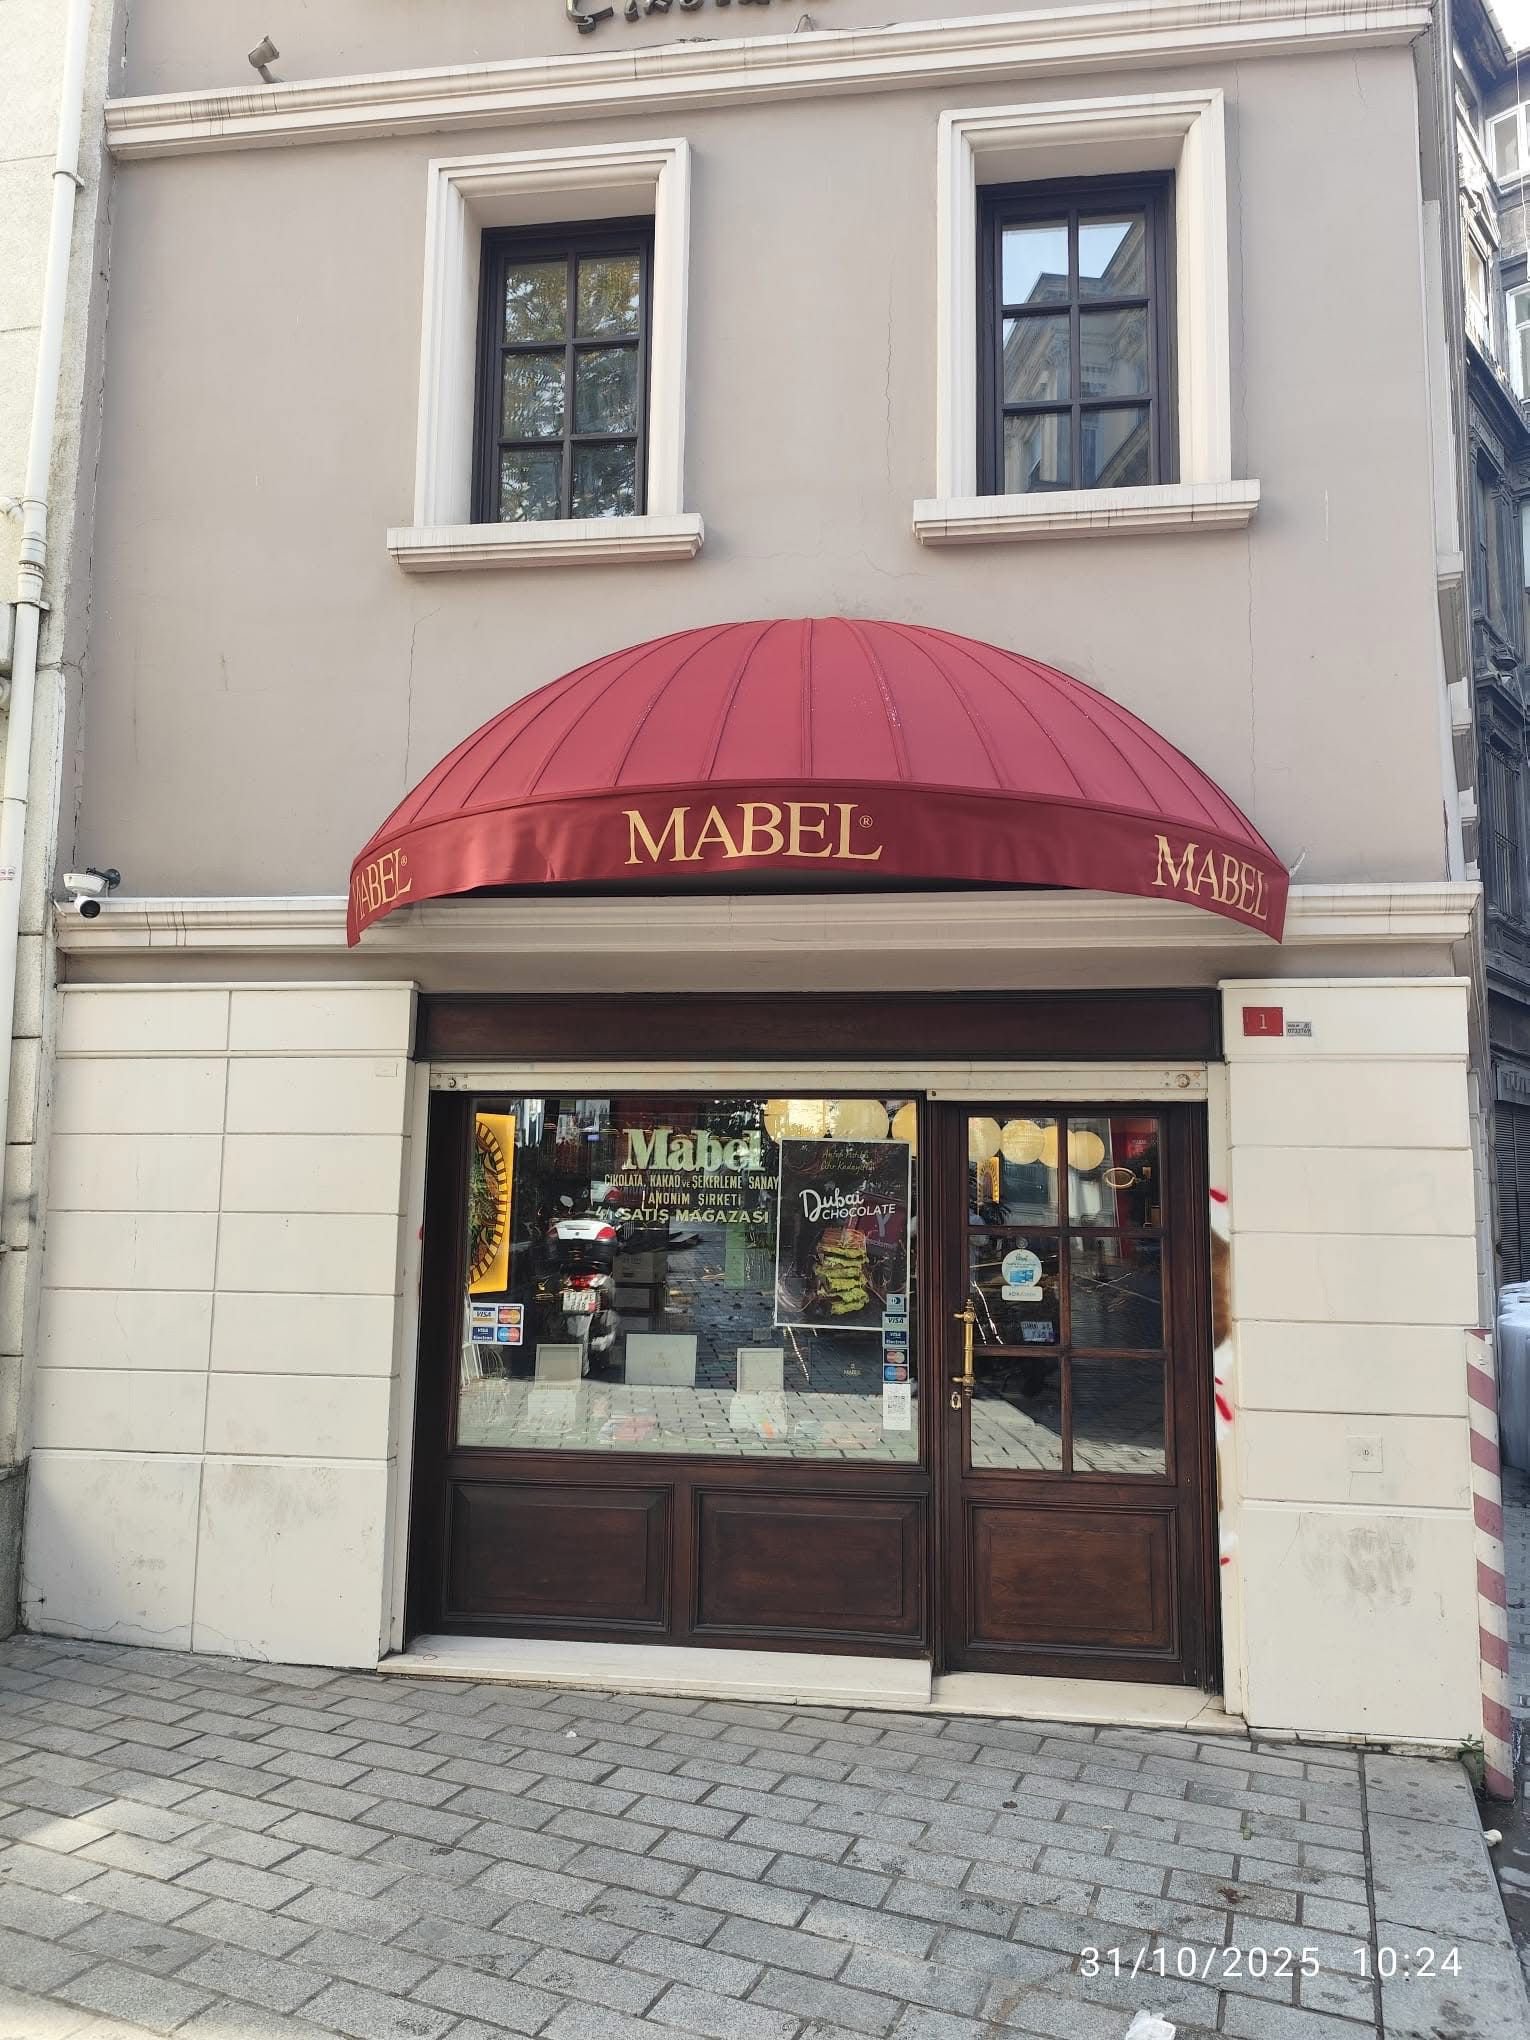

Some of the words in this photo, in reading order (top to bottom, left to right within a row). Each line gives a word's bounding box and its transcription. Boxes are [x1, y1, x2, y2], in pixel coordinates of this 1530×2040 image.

[1259, 1013, 1268, 1030] 1
[622, 1126, 766, 1172] Mabel
[650, 1174, 681, 1188] KAKAO
[692, 1175, 743, 1189] ŞEKERLEME
[648, 1192, 690, 1205] ANONİM
[698, 1193, 742, 1206] ŞİRKETİ
[799, 1187, 864, 1222] Dubai
[621, 1208, 669, 1224] SATIŞ
[675, 1207, 770, 1224] MAĞAZASI
[822, 1203, 897, 1220] CHOCOLATE
